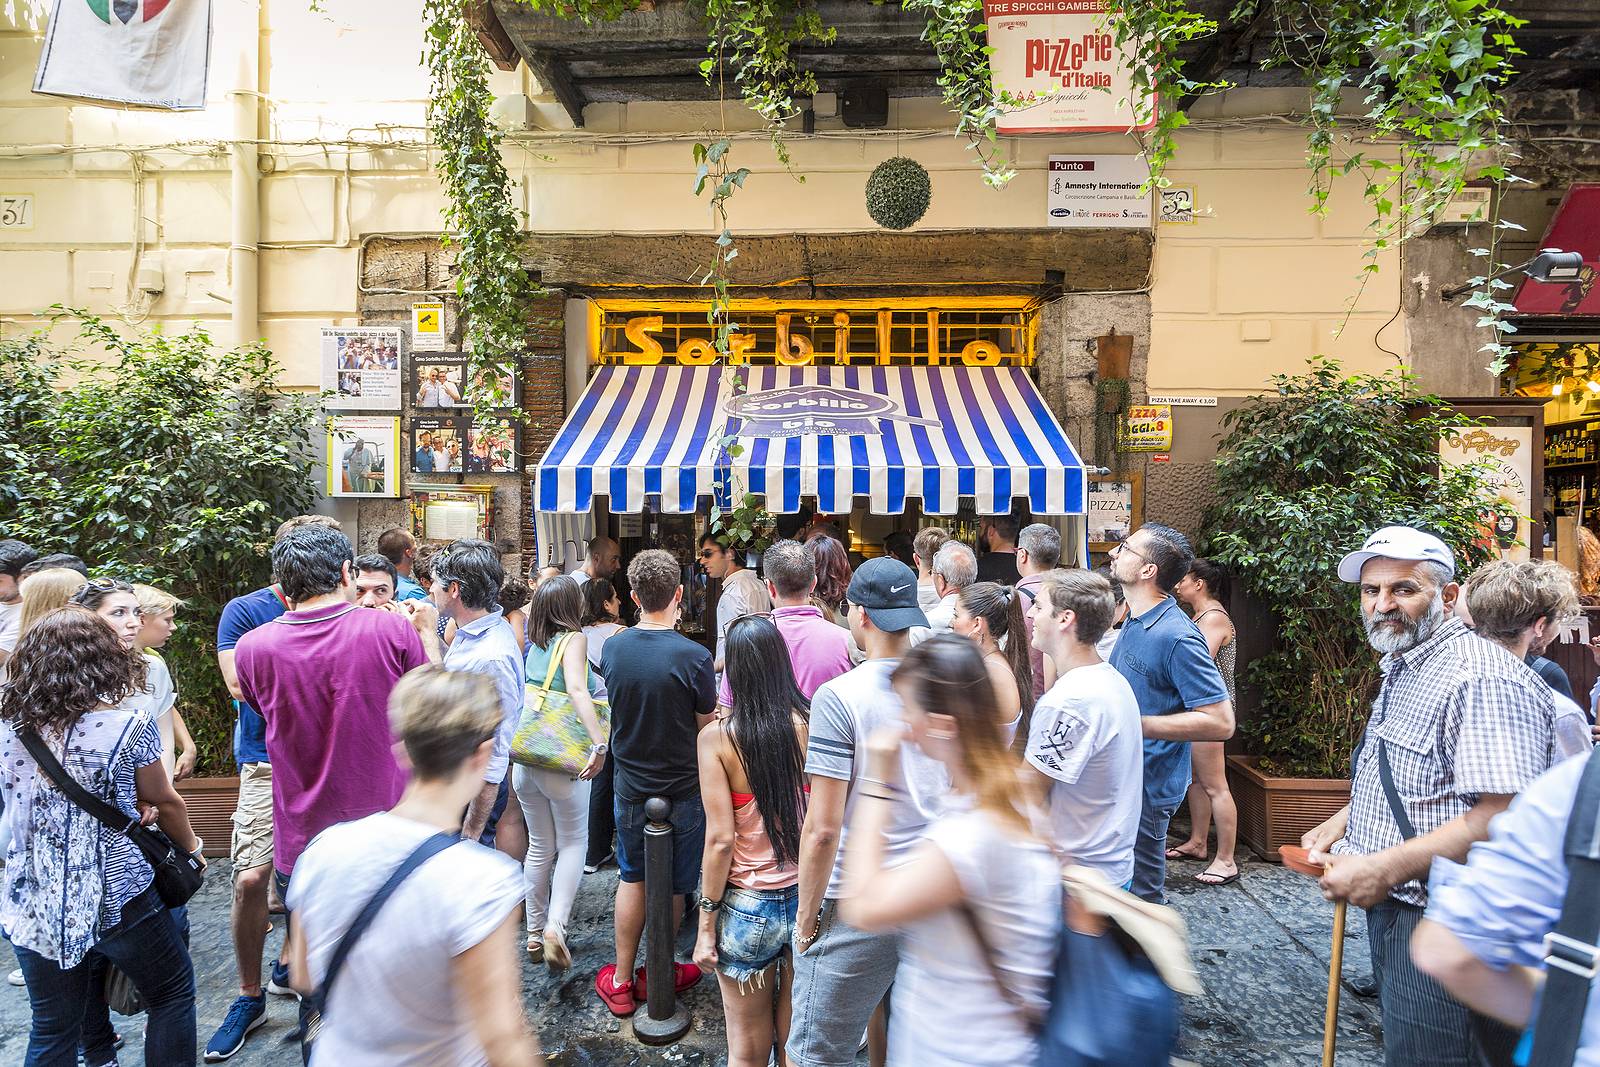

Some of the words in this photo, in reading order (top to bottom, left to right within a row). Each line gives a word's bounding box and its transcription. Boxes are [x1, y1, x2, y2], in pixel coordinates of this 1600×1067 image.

[988, 4, 1009, 12] TRE
[1012, 2, 1054, 11] SPICCHI
[1055, 162, 1084, 170] Punto
[1065, 182, 1097, 190] Amnesty
[3, 199, 28, 225] 31
[624, 311, 1001, 367] Sorbillo
[741, 398, 870, 412] Sorbillo
[782, 417, 836, 429] bio
[1156, 420, 1165, 432] 8
[1090, 500, 1125, 511] PIZZA
